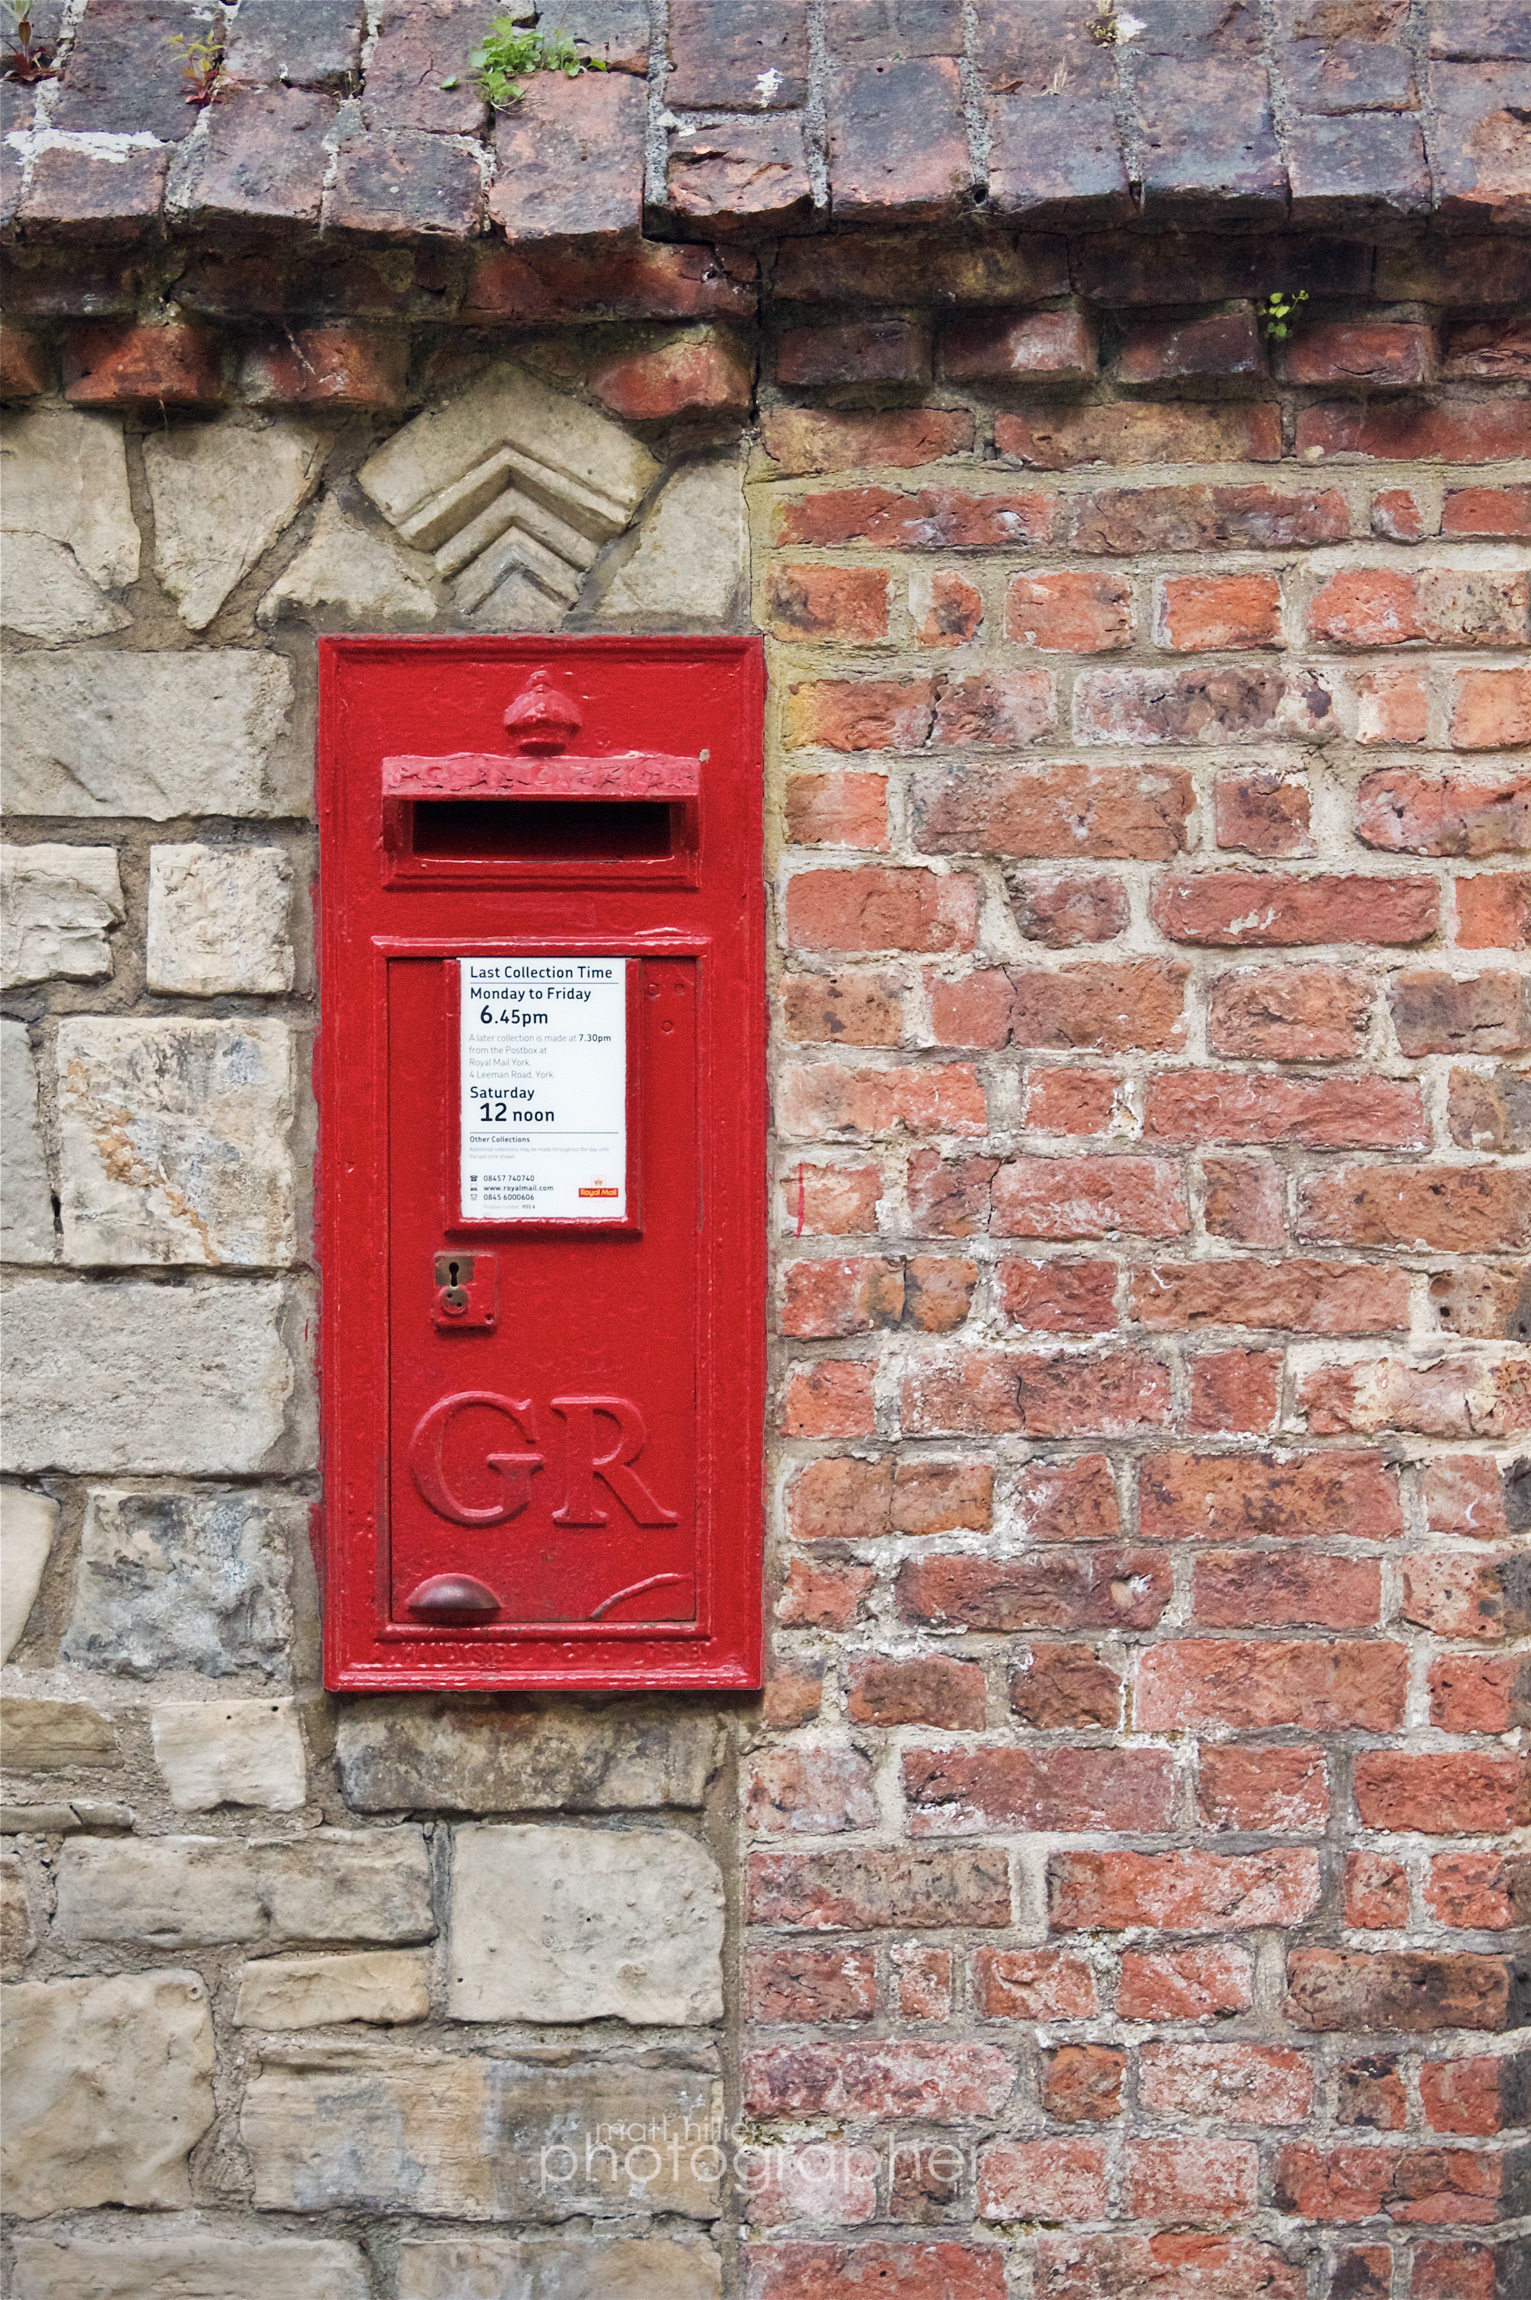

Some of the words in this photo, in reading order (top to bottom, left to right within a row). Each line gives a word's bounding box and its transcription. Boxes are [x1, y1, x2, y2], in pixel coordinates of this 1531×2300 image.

[470, 966, 501, 979] Last
[504, 966, 574, 979] Collection
[577, 966, 613, 979] Time
[470, 987, 526, 1002] Monday
[529, 988, 543, 1000] to
[547, 987, 592, 1002] Friday
[480, 1004, 549, 1028] 6.45pm
[469, 1034, 475, 1042] A
[476, 1034, 495, 1042] later
[497, 1034, 534, 1042] collection
[536, 1034, 543, 1042] is
[544, 1034, 567, 1042] made
[578, 1034, 612, 1043] 7.30pm
[469, 1046, 489, 1054] from
[490, 1046, 504, 1054] the
[505, 1046, 538, 1054] Postbox
[539, 1046, 547, 1054] at
[469, 1058, 492, 1068] Royal
[493, 1058, 510, 1066] Mail
[469, 1070, 475, 1079] 4
[476, 1070, 510, 1079] Leeman
[470, 1086, 535, 1102] Saturday
[480, 1102, 507, 1122] 12
[512, 1110, 555, 1122] noon
[483, 1174, 506, 1182] 08457
[508, 1174, 535, 1182] 740740
[483, 1184, 554, 1192] www.royalmail.com
[409, 1390, 679, 1530] GR
